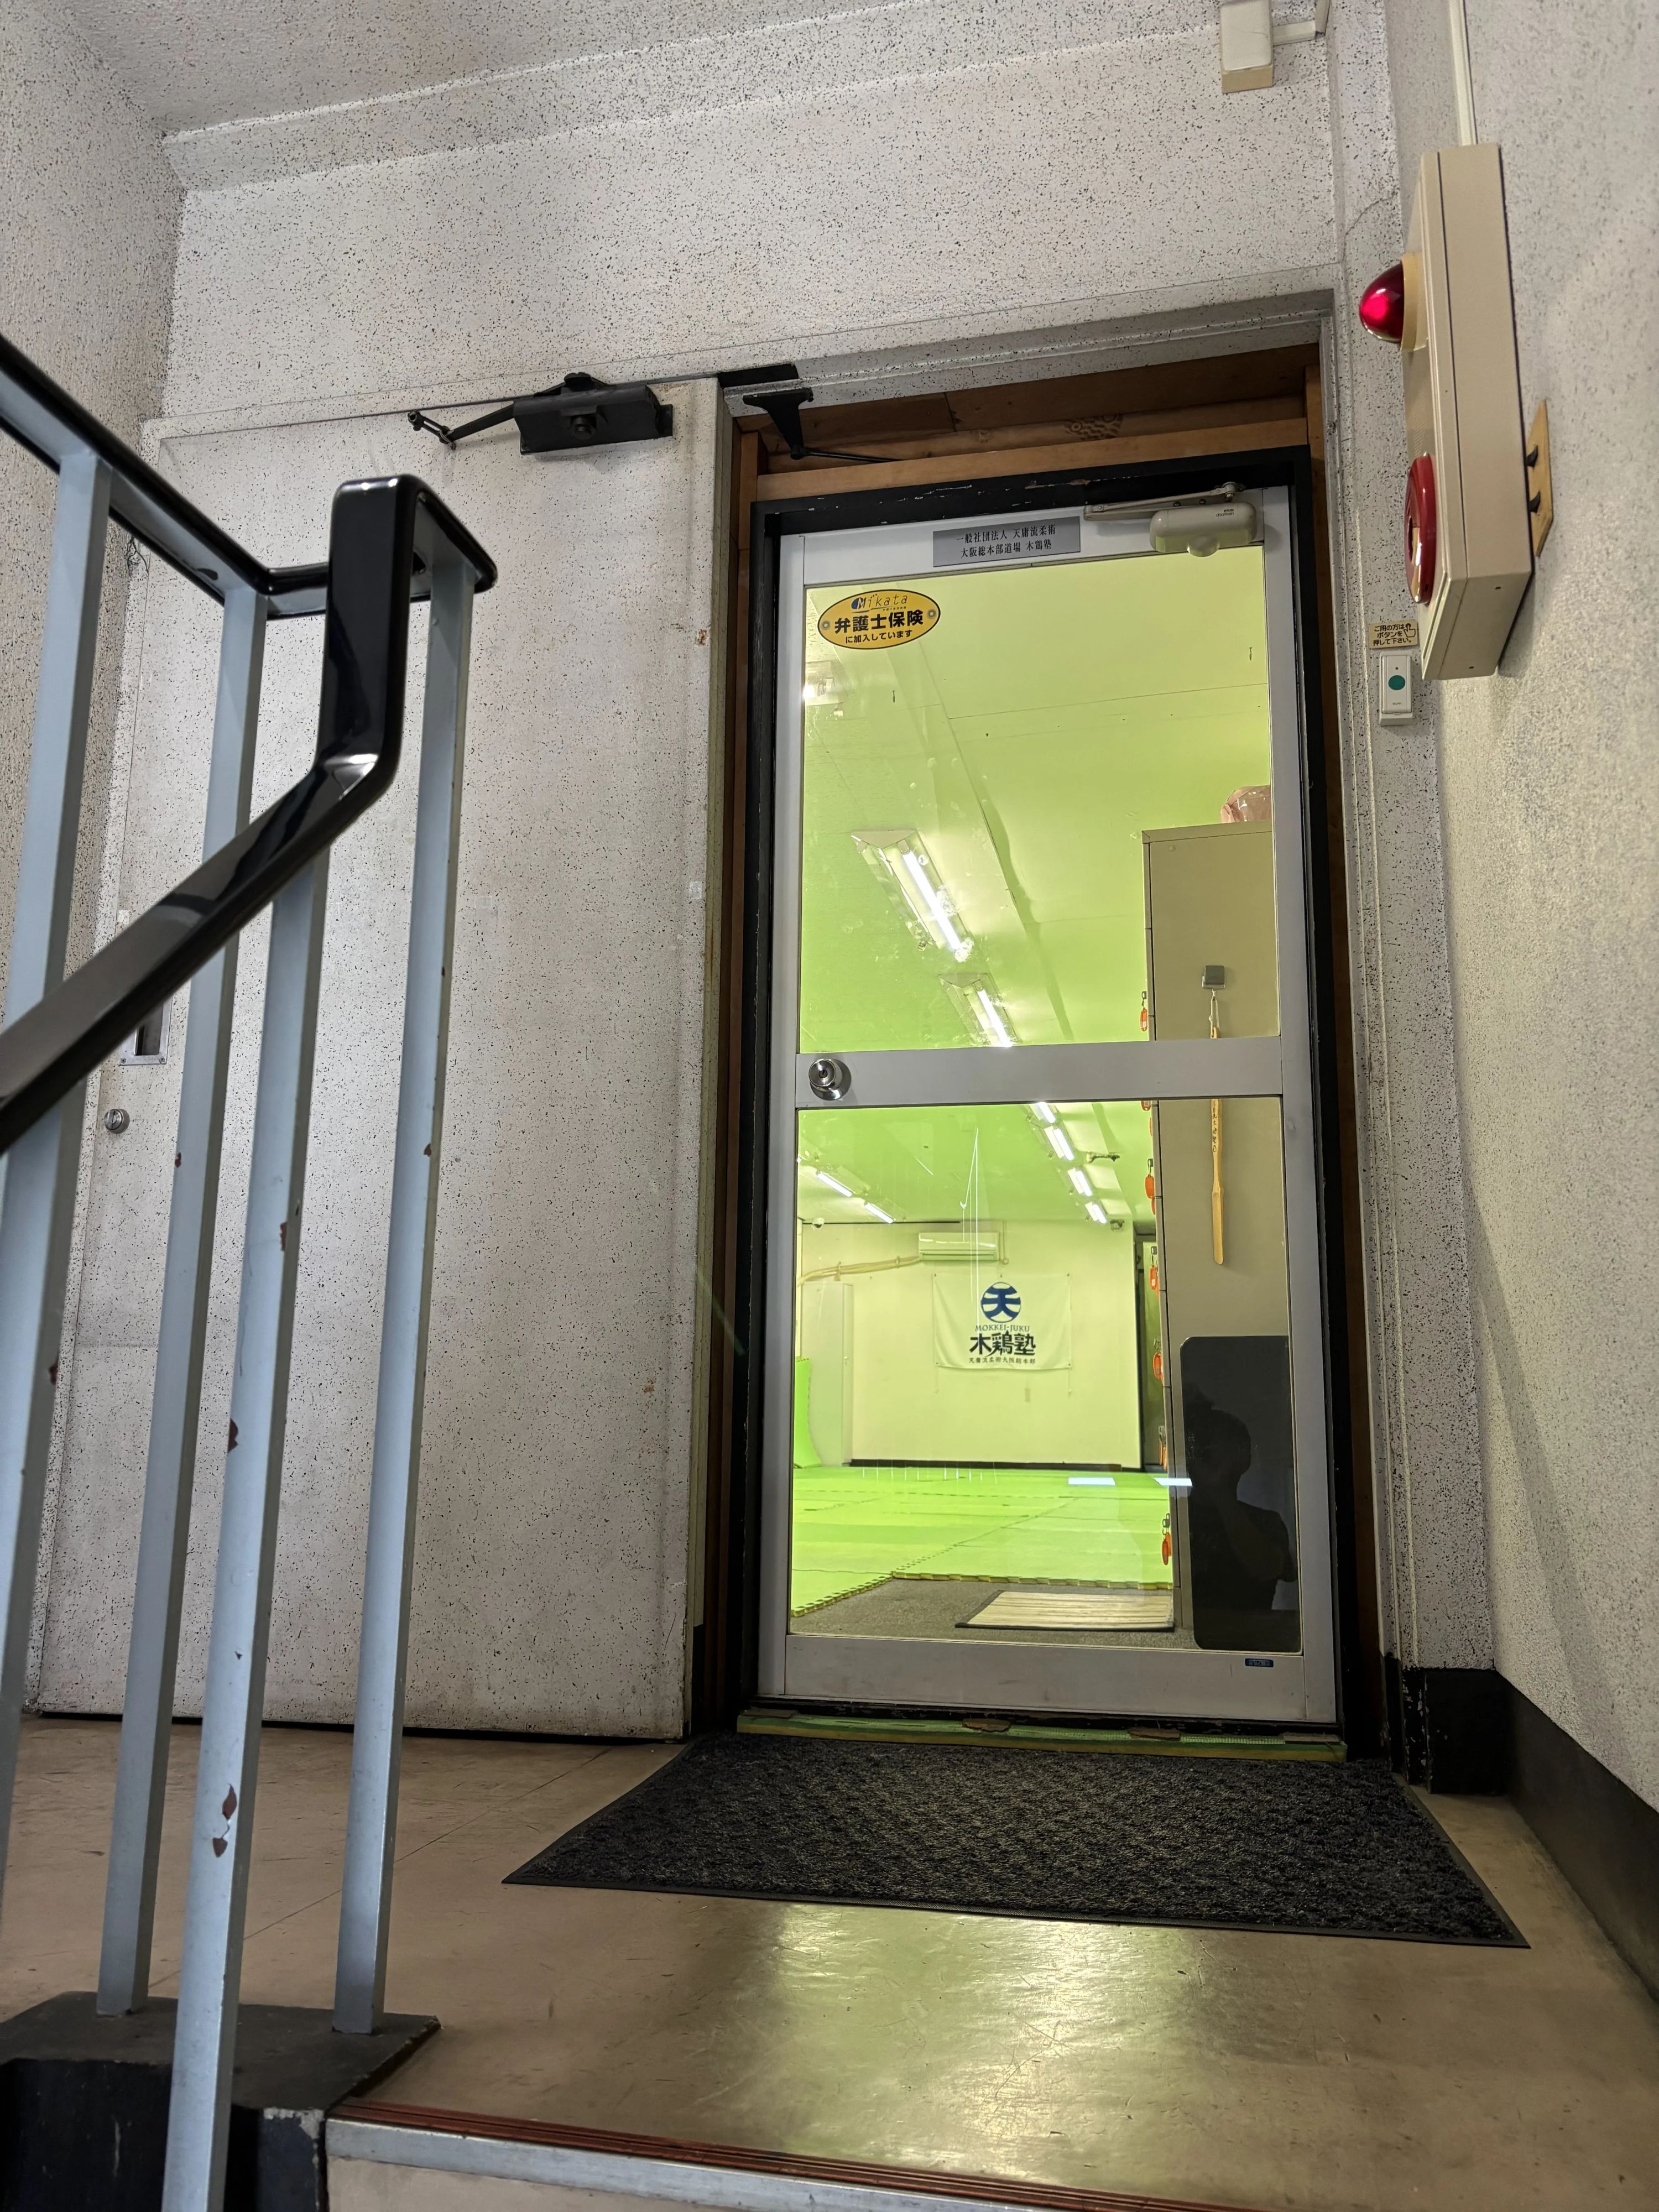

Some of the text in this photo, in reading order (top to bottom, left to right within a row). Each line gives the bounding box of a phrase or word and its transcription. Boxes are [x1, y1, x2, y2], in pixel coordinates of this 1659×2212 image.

[956, 531, 1007, 544] 一般社団法人
[961, 539, 1051, 558] 大阪総本部道場 木鶏塾
[855, 593, 907, 609] Mikata
[834, 609, 924, 634] 弁護士保険
[846, 629, 913, 644] に加入しています
[975, 1324, 1030, 1332] MOKKEI-JUKU
[969, 1330, 1036, 1358] 木鶏塾
